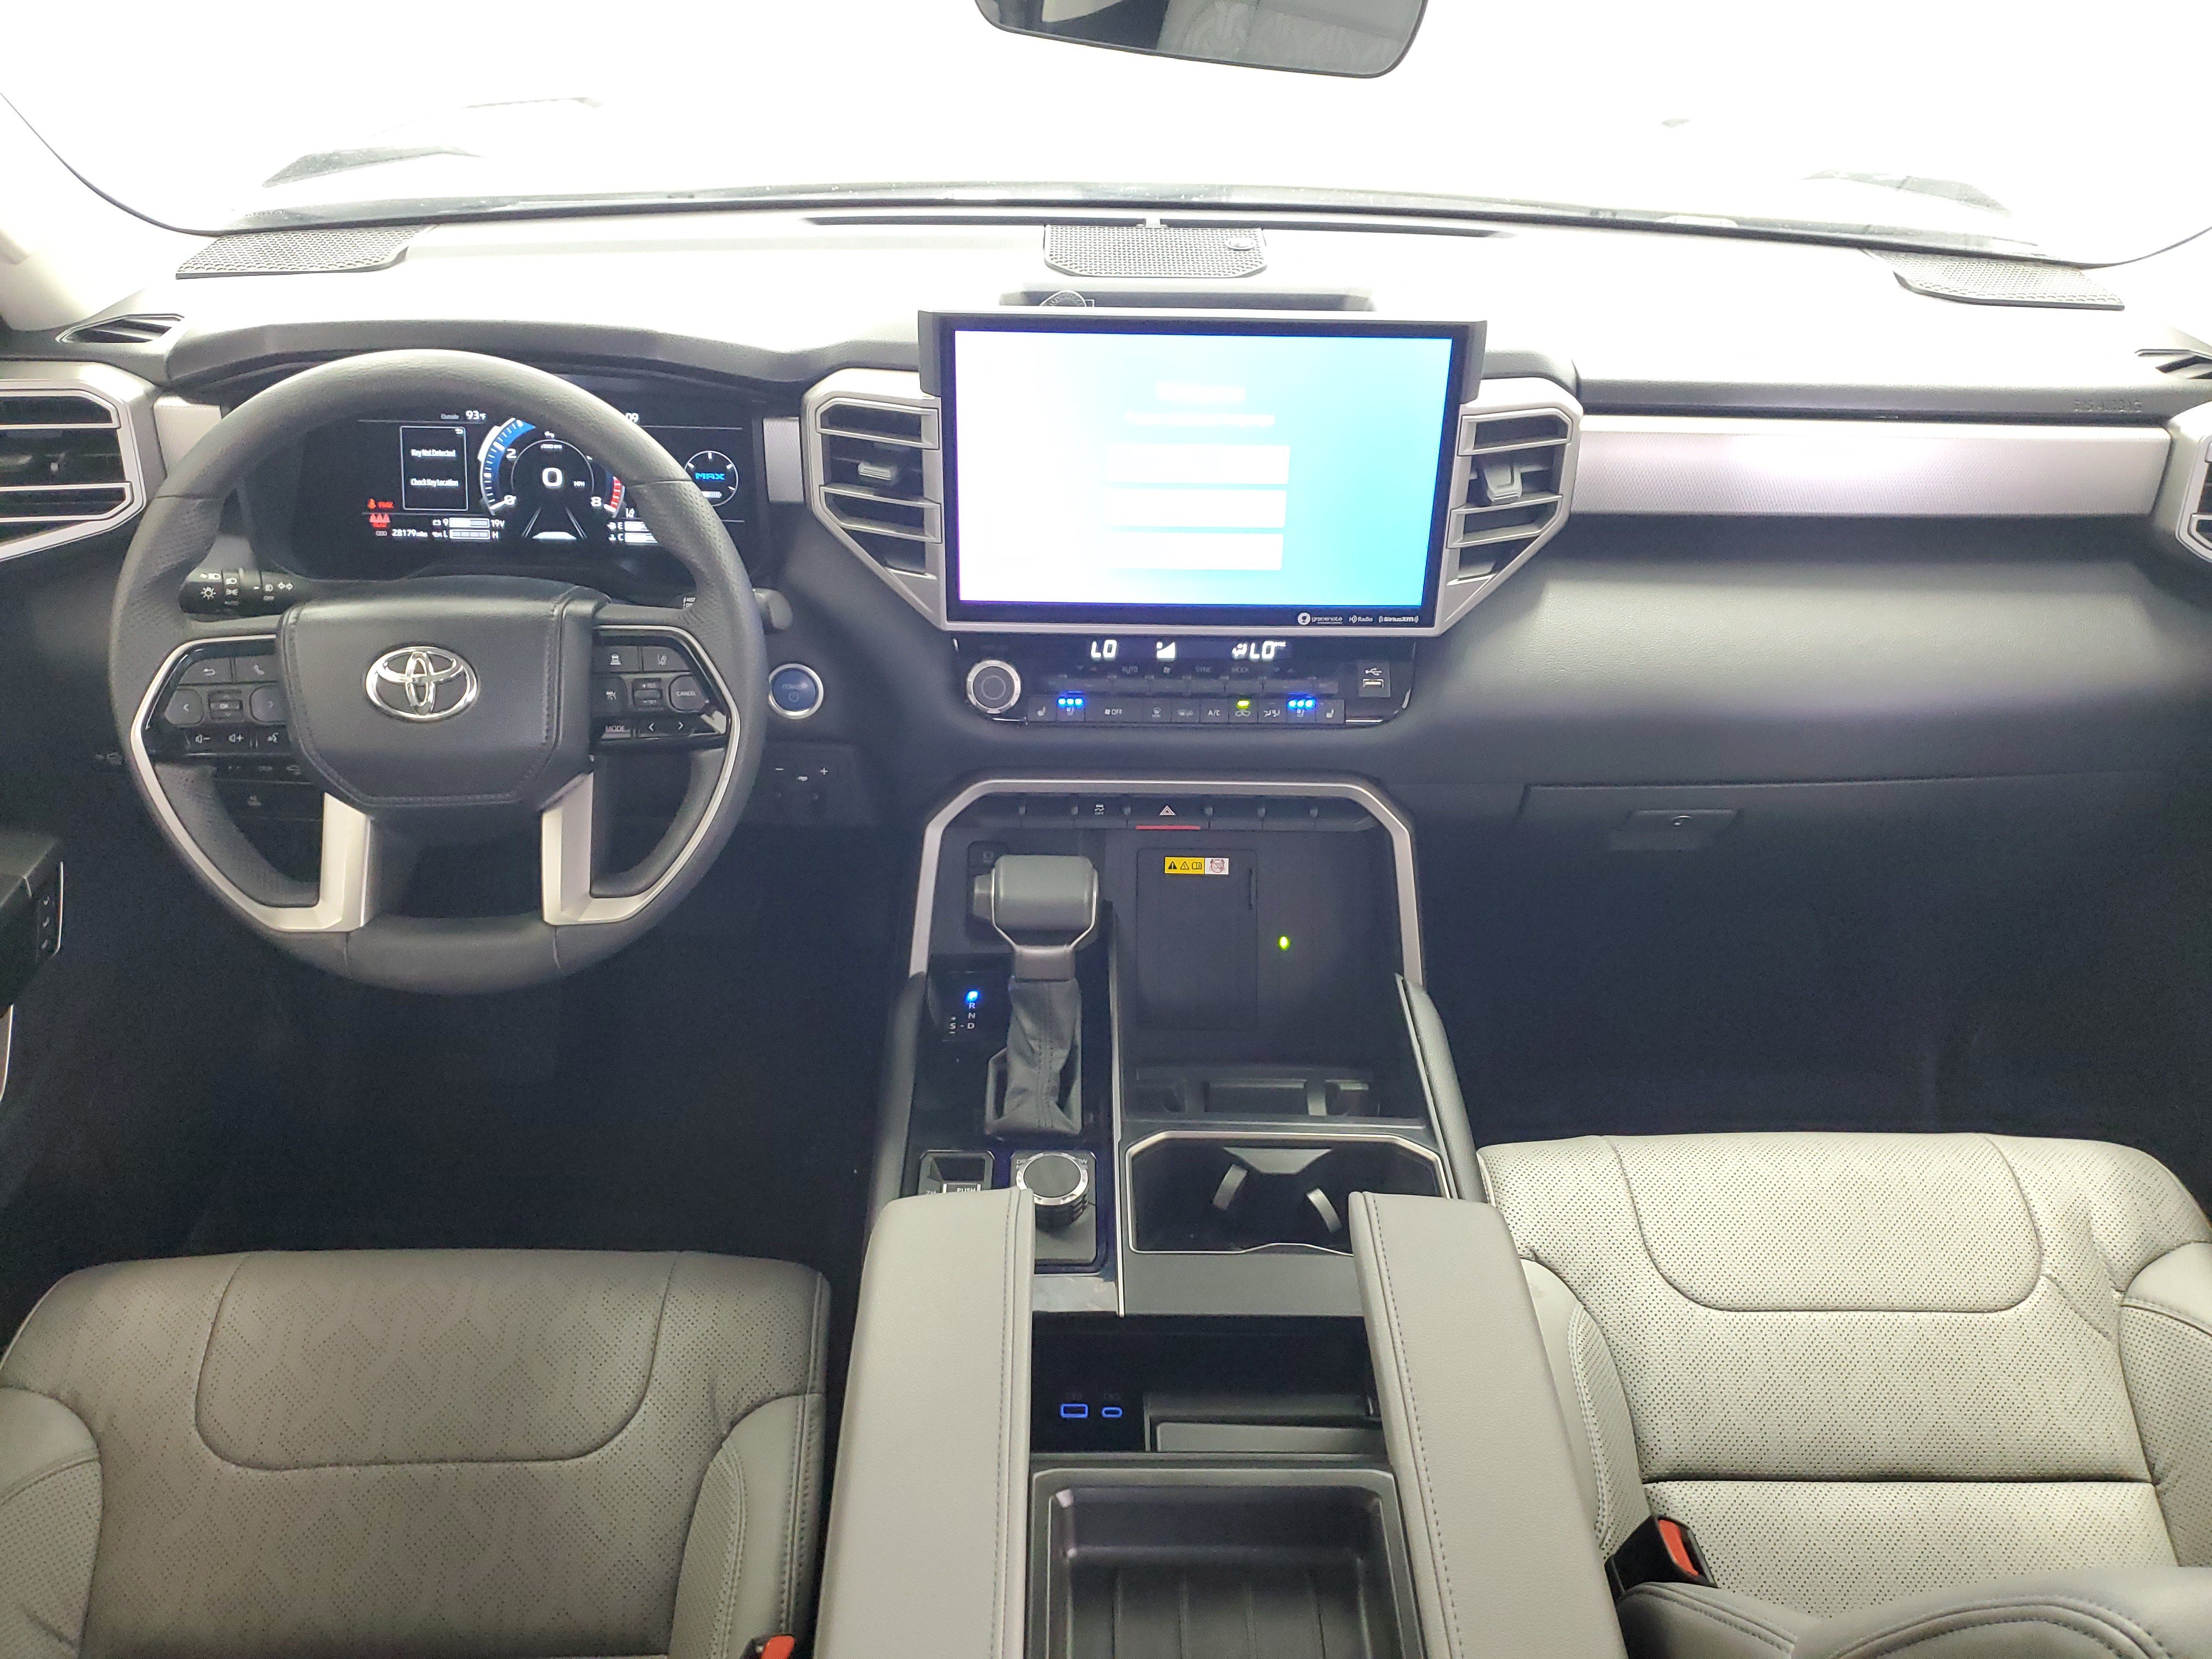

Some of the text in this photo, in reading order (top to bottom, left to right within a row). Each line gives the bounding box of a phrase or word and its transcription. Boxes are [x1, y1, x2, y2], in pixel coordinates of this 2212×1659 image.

[411, 449, 421, 458] Key
[432, 449, 456, 457] Detected
[506, 448, 517, 459] 2
[427, 478, 437, 487] Key
[542, 467, 563, 488] 0
[590, 496, 602, 507] 8
[492, 531, 499, 539] H
